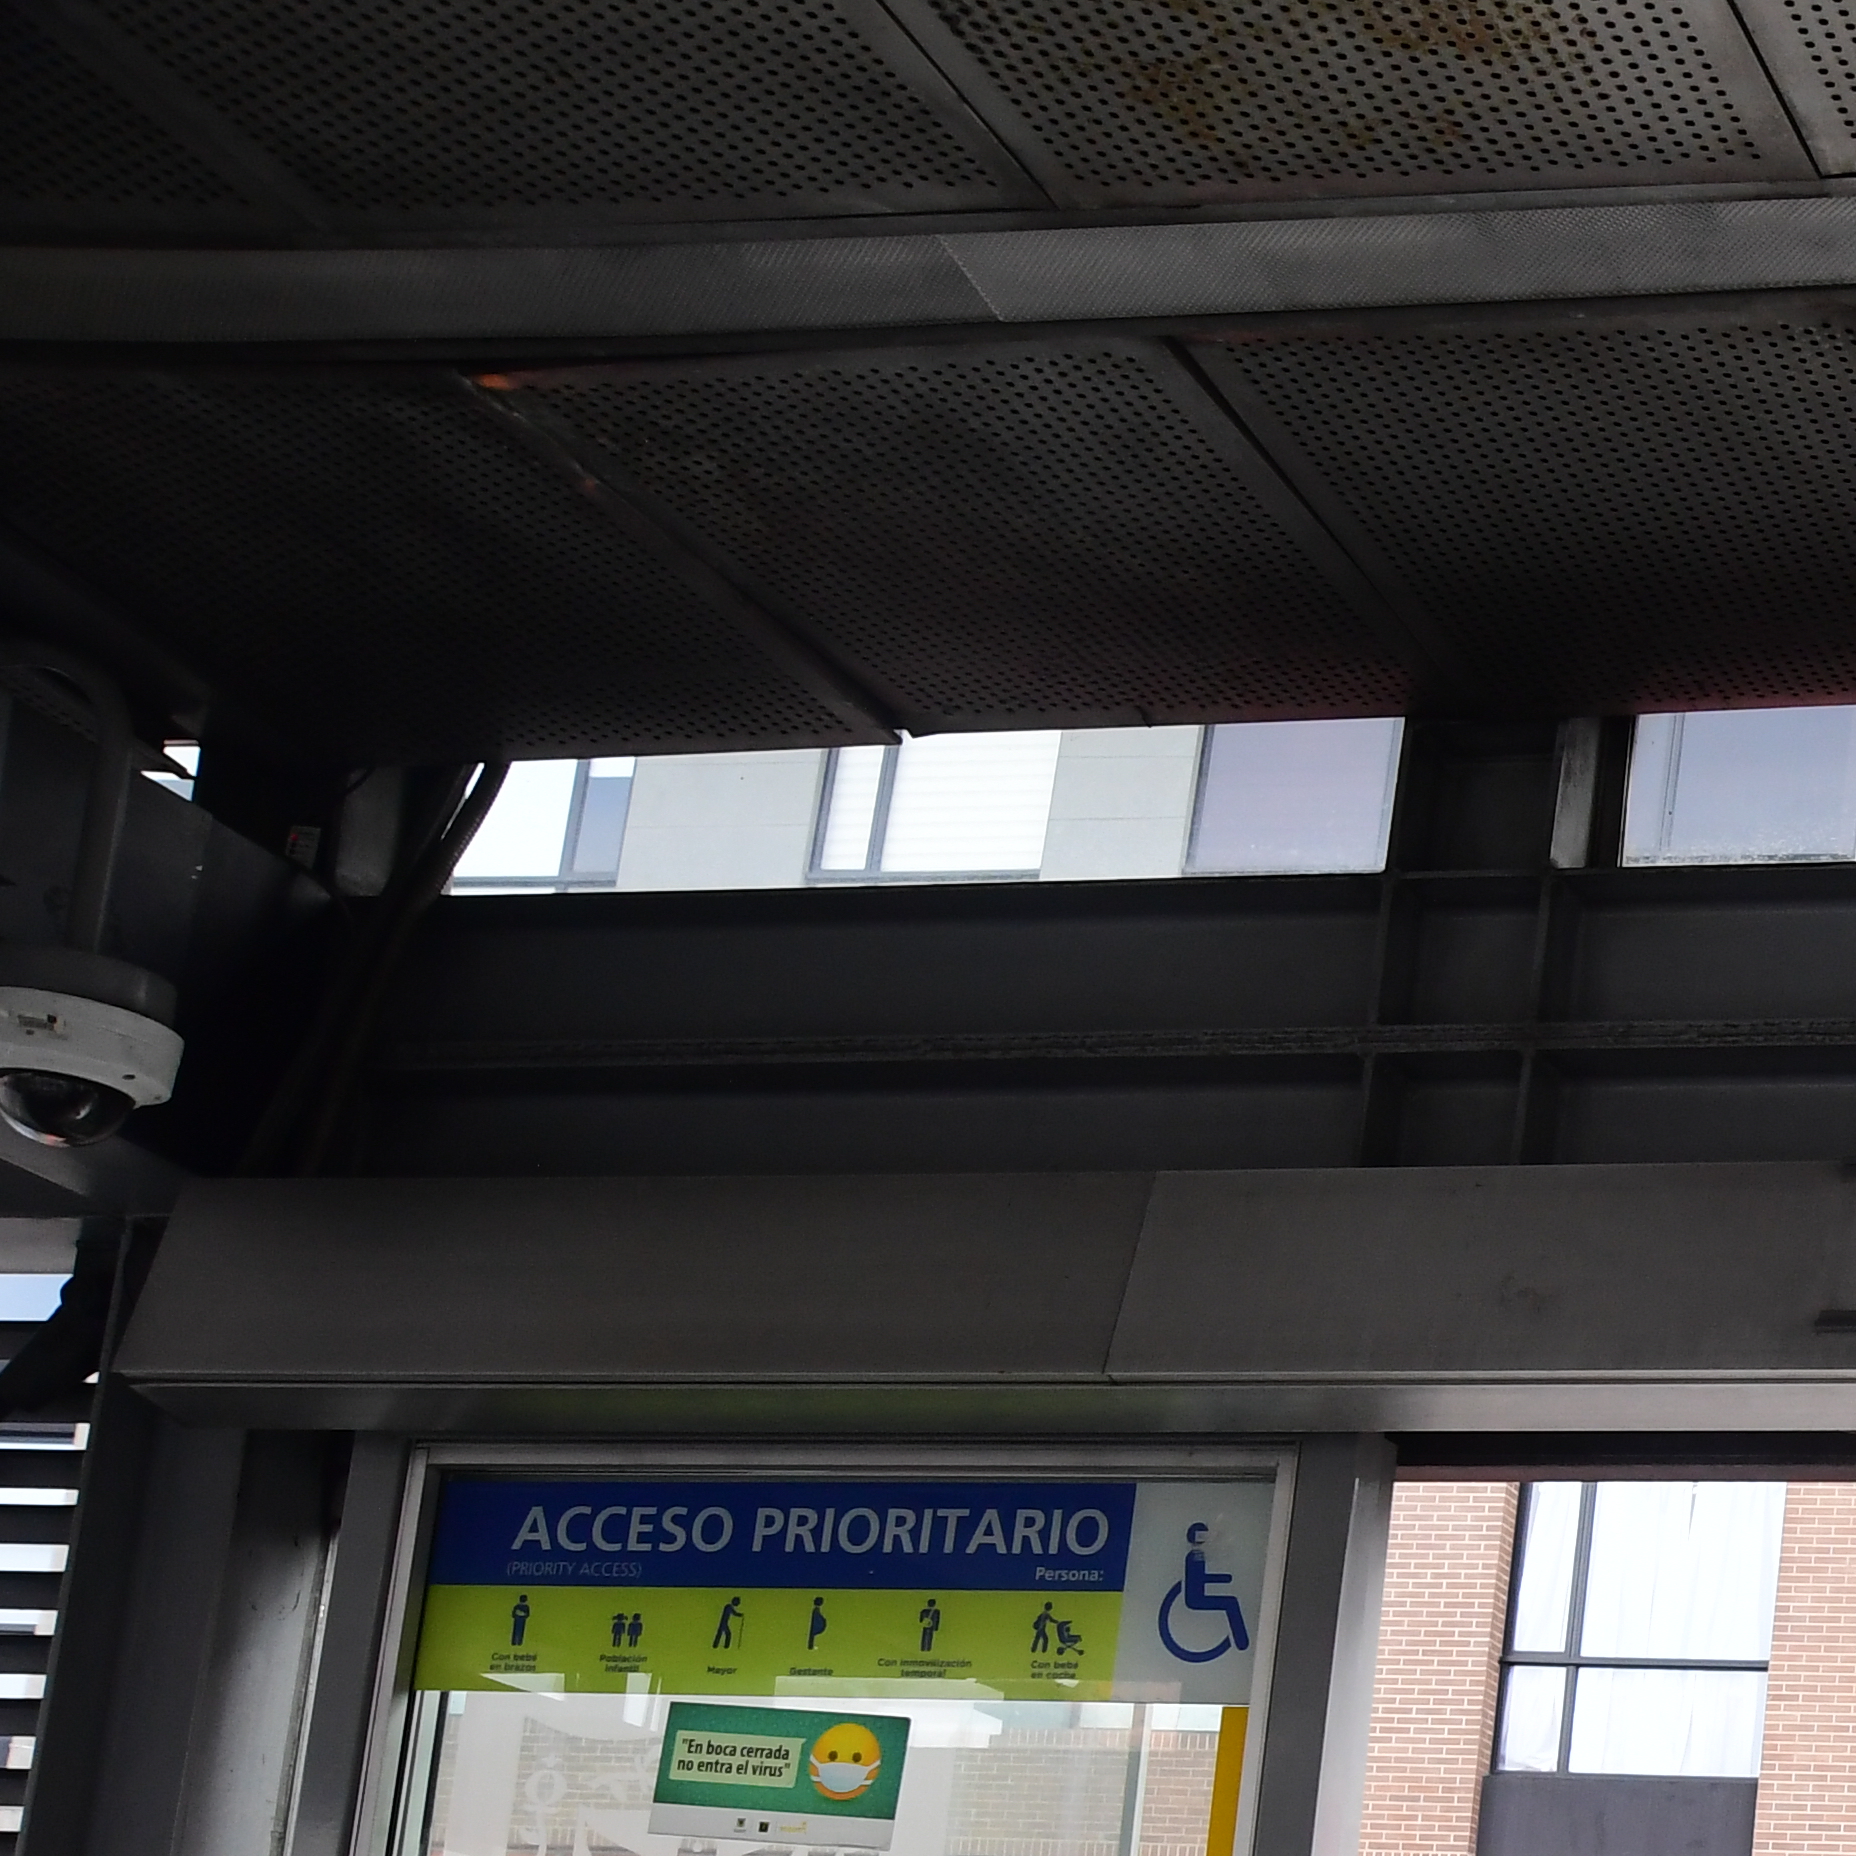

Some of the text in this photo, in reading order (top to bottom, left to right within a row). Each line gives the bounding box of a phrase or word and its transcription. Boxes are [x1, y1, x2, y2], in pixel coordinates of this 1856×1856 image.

[511, 1505, 1110, 1556] ACCESO PRIORITARIO
[506, 1561, 643, 1579] (PRIORITY ACCESS)
[1035, 1566, 1105, 1582] Persona:
[877, 1658, 898, 1668] Con
[706, 1740, 737, 1757] boca
[740, 1745, 790, 1760] cerrada
[677, 1759, 694, 1771] no
[697, 1760, 733, 1774] entra
[736, 1760, 749, 1775] el
